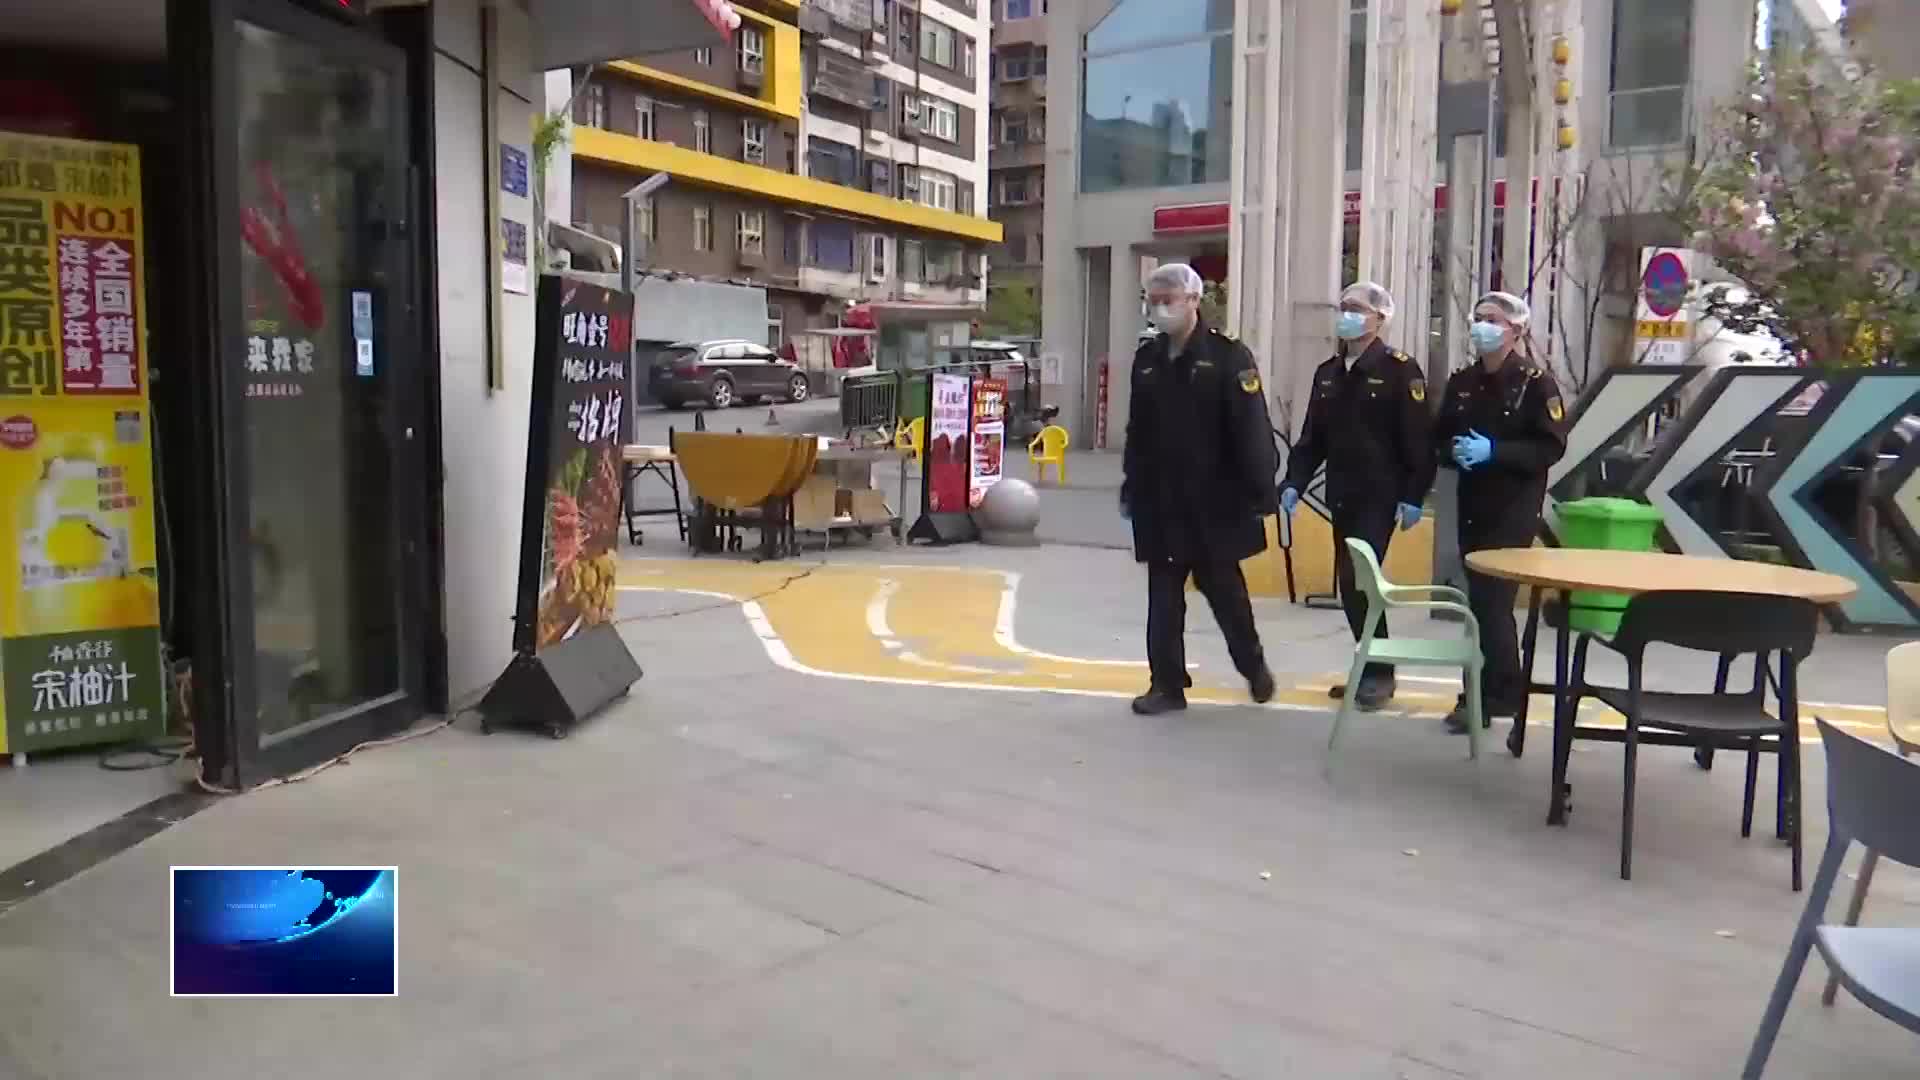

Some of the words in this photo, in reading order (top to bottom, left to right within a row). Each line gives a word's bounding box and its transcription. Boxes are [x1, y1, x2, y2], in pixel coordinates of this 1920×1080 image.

[93, 241, 137, 388] 全国销量
[31, 660, 137, 712] 宋柚汁
